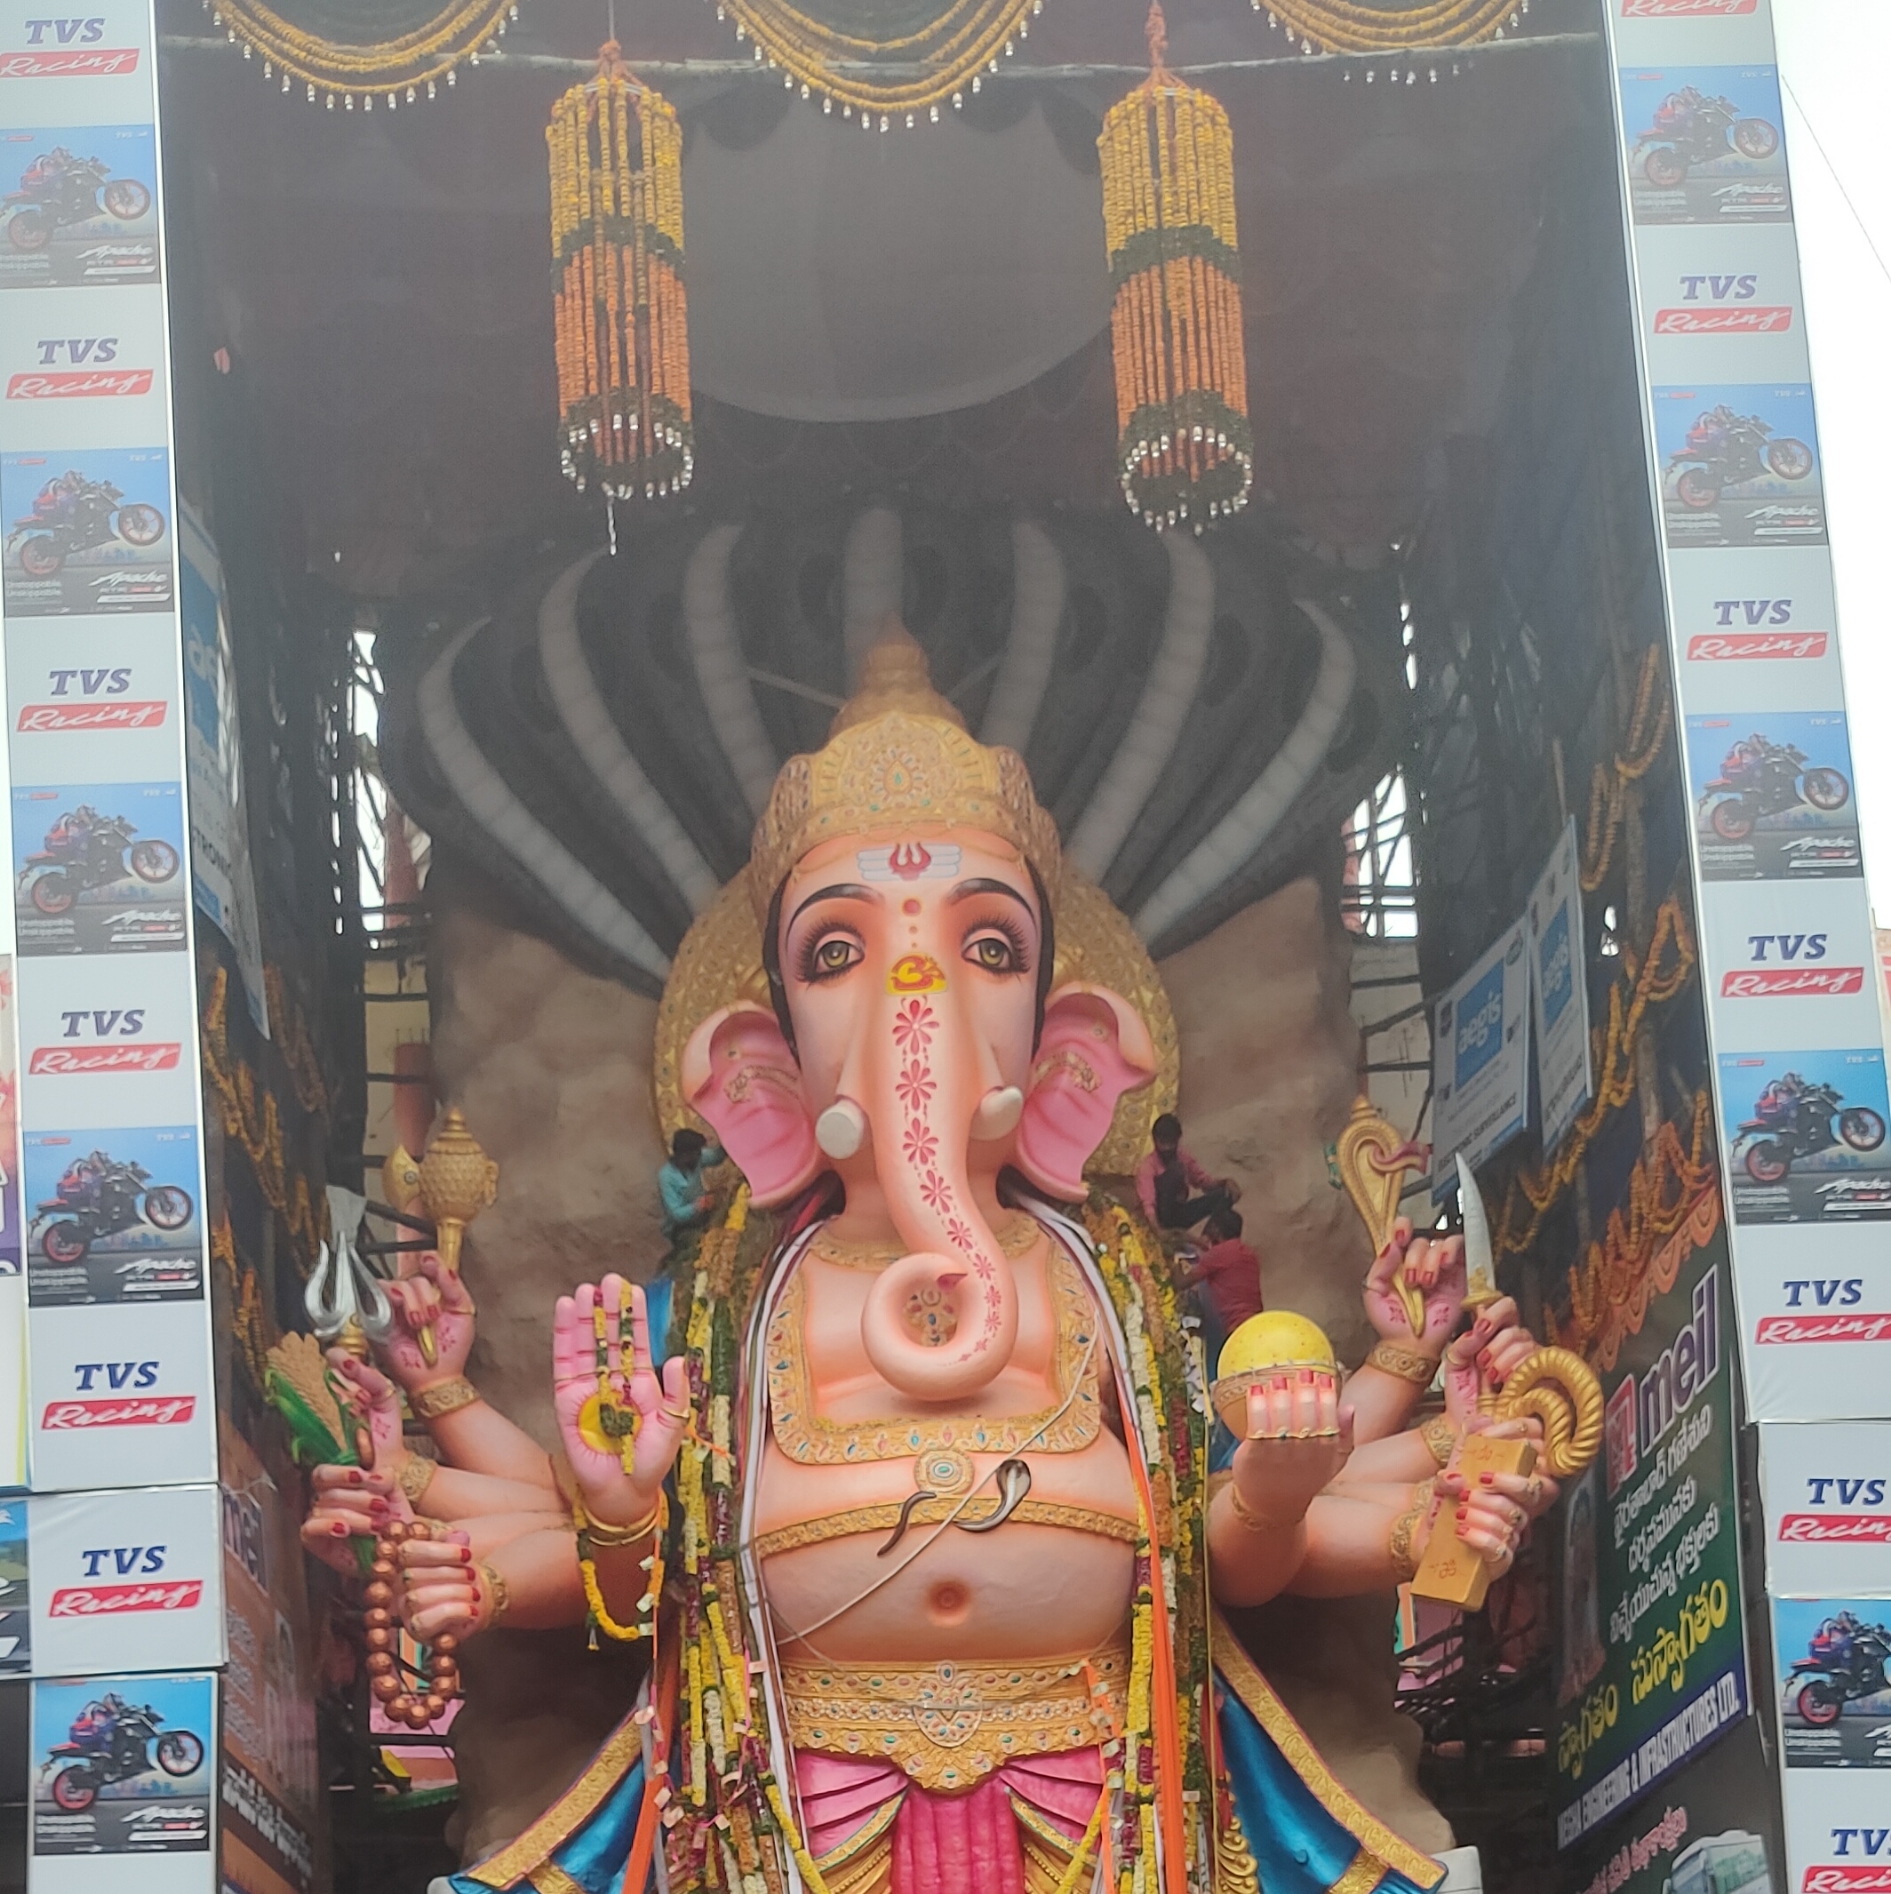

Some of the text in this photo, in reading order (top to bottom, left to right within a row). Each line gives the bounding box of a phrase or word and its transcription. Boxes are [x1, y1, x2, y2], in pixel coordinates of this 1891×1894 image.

[26, 18, 104, 44] TVS
[1, 52, 137, 76] Racing
[1680, 275, 1757, 300] TVS
[1658, 308, 1789, 332] Racing
[37, 338, 118, 364] TVS
[9, 372, 149, 398] Racing
[1714, 598, 1792, 625] TVS
[1692, 634, 1824, 659] Racing
[49, 669, 132, 695] TVS
[22, 703, 163, 730] Racing
[1749, 934, 1827, 961] TVS
[1726, 969, 1861, 995] Racing
[62, 1010, 144, 1037] TVS
[1458, 990, 1502, 1054] aegis
[35, 1044, 178, 1073] Racing
[1783, 1279, 1863, 1307] TVS
[1640, 1263, 1721, 1458] meil
[75, 1362, 160, 1390] TVS
[47, 1398, 193, 1429] Racing
[1807, 1478, 1887, 1505] TVS
[83, 1546, 166, 1576] TVS
[54, 1582, 201, 1616] Racing
[1631, 1578, 1729, 1705] సుస్వాగతం
[1639, 1685, 1719, 1786] INFRASTRUCTURES
[1717, 1671, 1741, 1723] LTD.
[1831, 1829, 1891, 1855] TV
[1806, 1868, 1891, 1893] Raci
